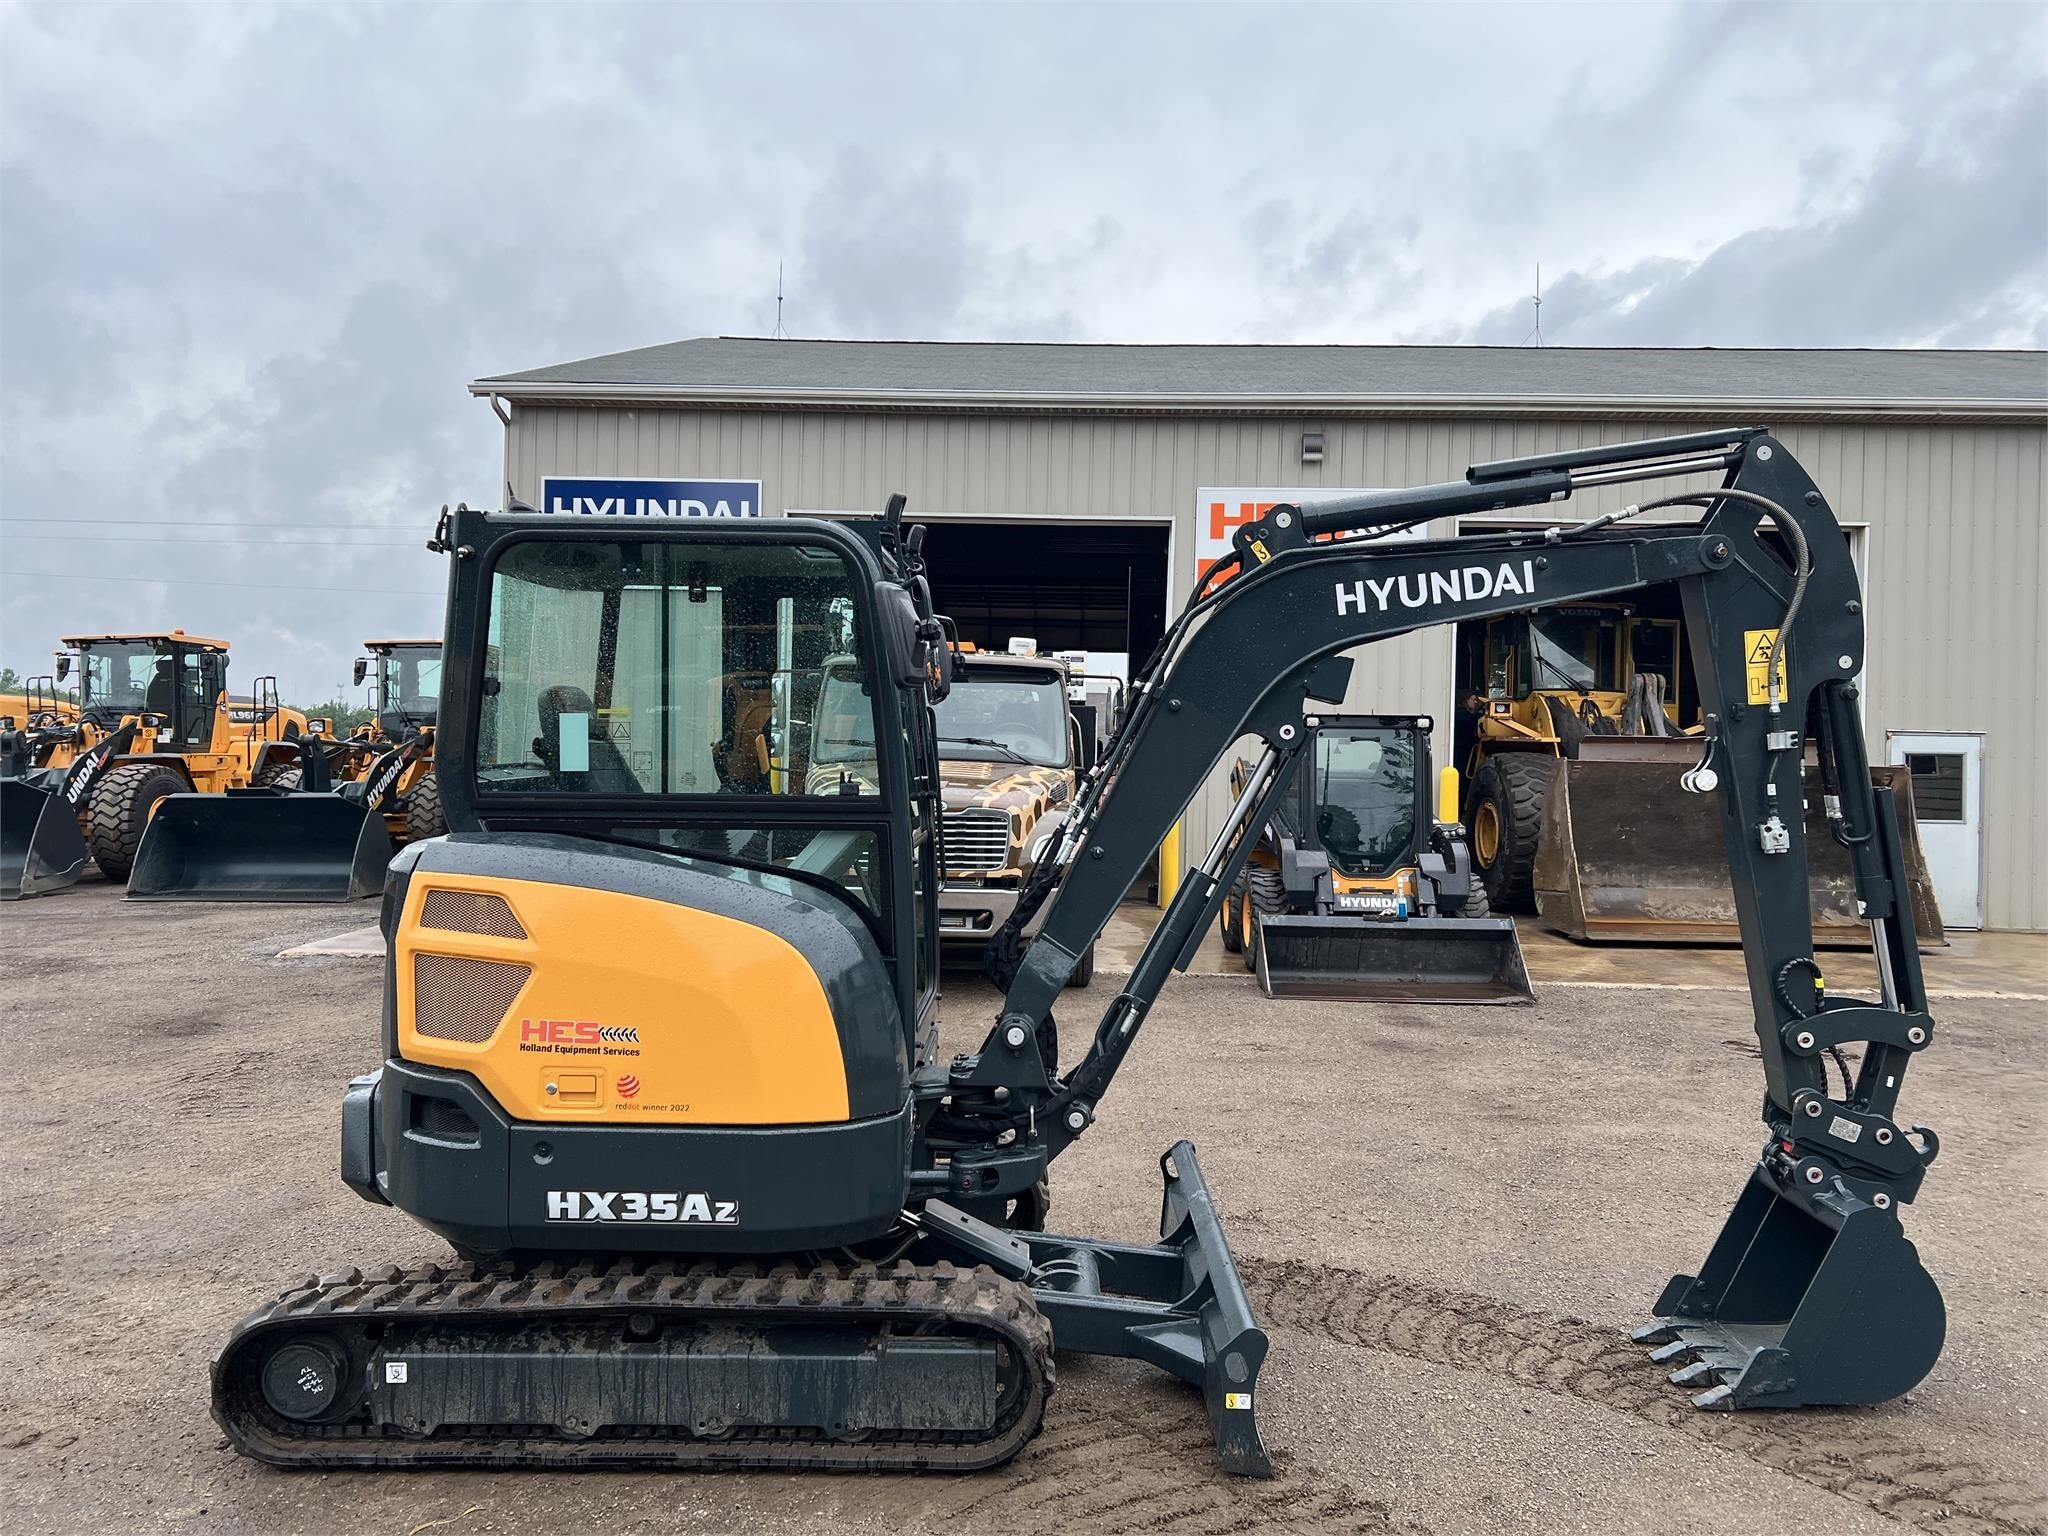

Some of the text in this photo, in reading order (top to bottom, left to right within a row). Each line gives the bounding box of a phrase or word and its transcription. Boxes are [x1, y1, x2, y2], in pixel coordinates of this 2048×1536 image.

[1335, 560, 1535, 616] HYUNDAI
[66, 751, 99, 804] UNDAI
[366, 755, 404, 807] HYUNDAI
[1341, 897, 1400, 908] HYUNDA
[521, 1020, 600, 1044] HES
[520, 1043, 640, 1057] Holland Equipment Services
[642, 1104, 668, 1112] winner
[670, 1104, 690, 1112] 2022
